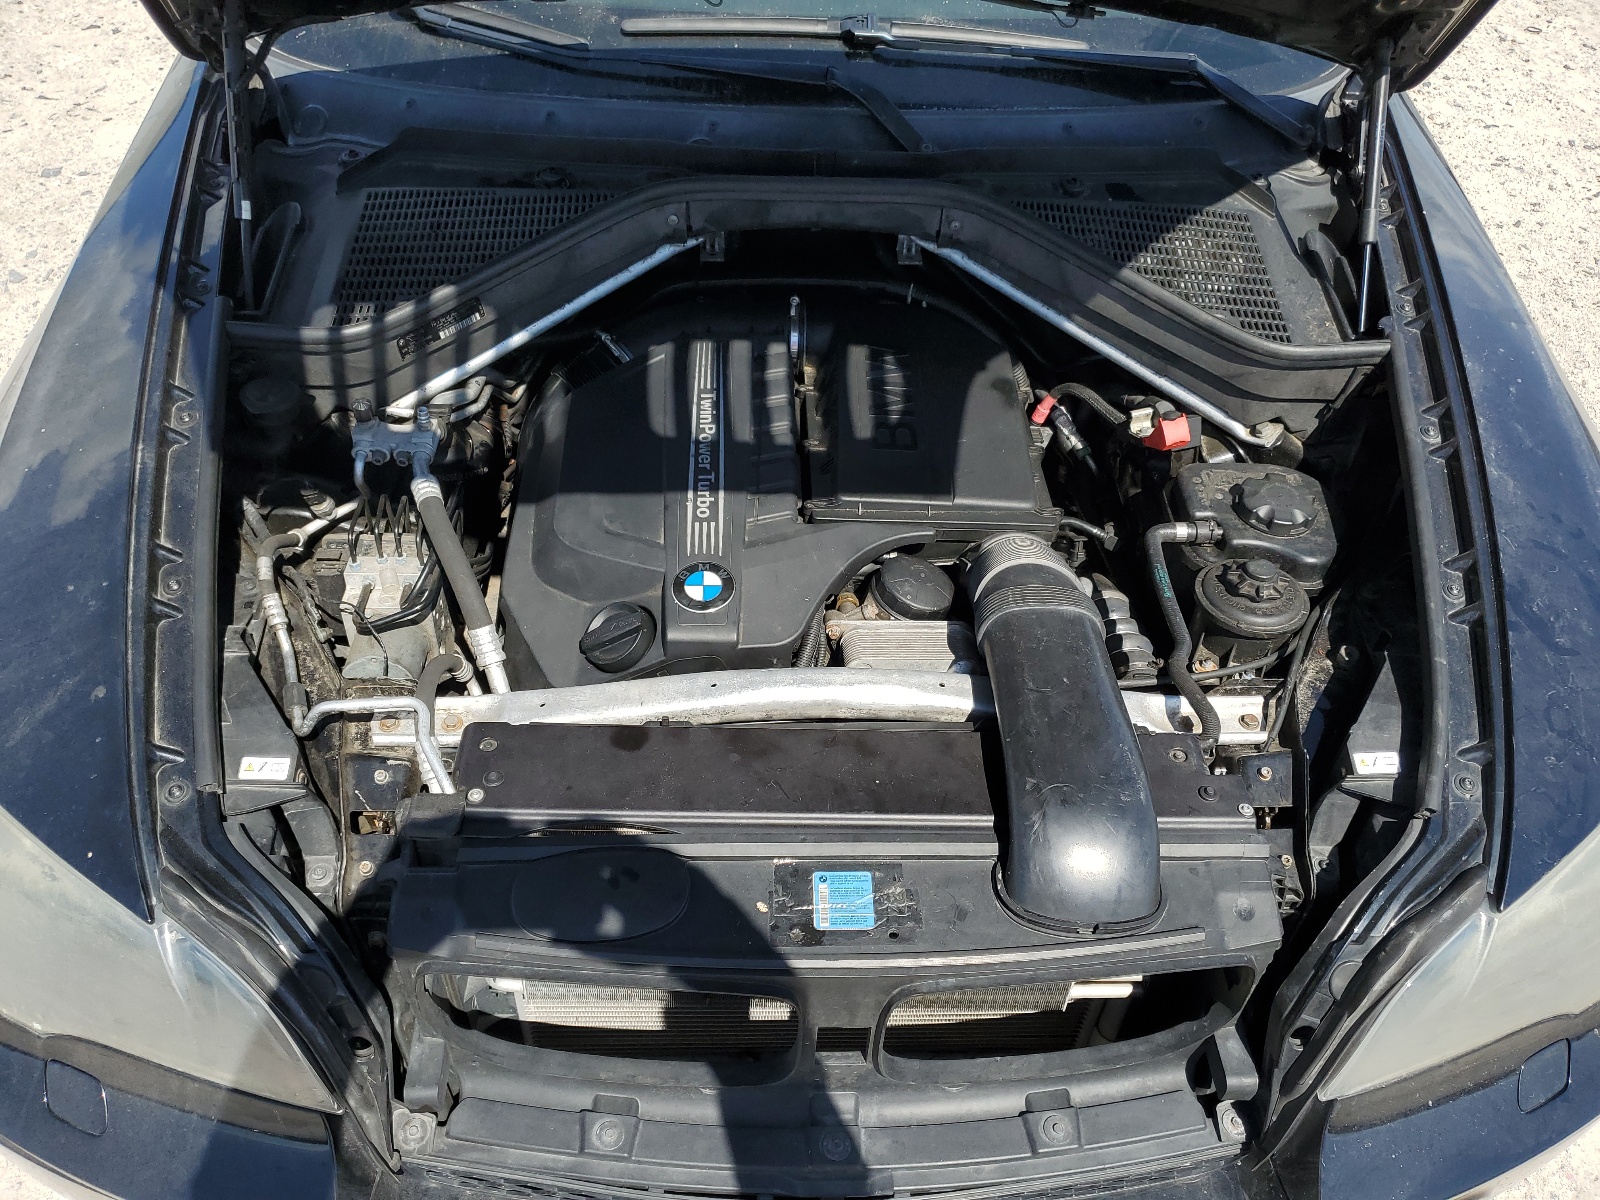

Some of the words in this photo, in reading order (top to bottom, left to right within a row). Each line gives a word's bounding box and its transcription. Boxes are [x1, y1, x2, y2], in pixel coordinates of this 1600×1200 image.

[698, 390, 717, 470] TwinPower
[696, 471, 716, 518] Turbo
[677, 563, 730, 581] BMW
